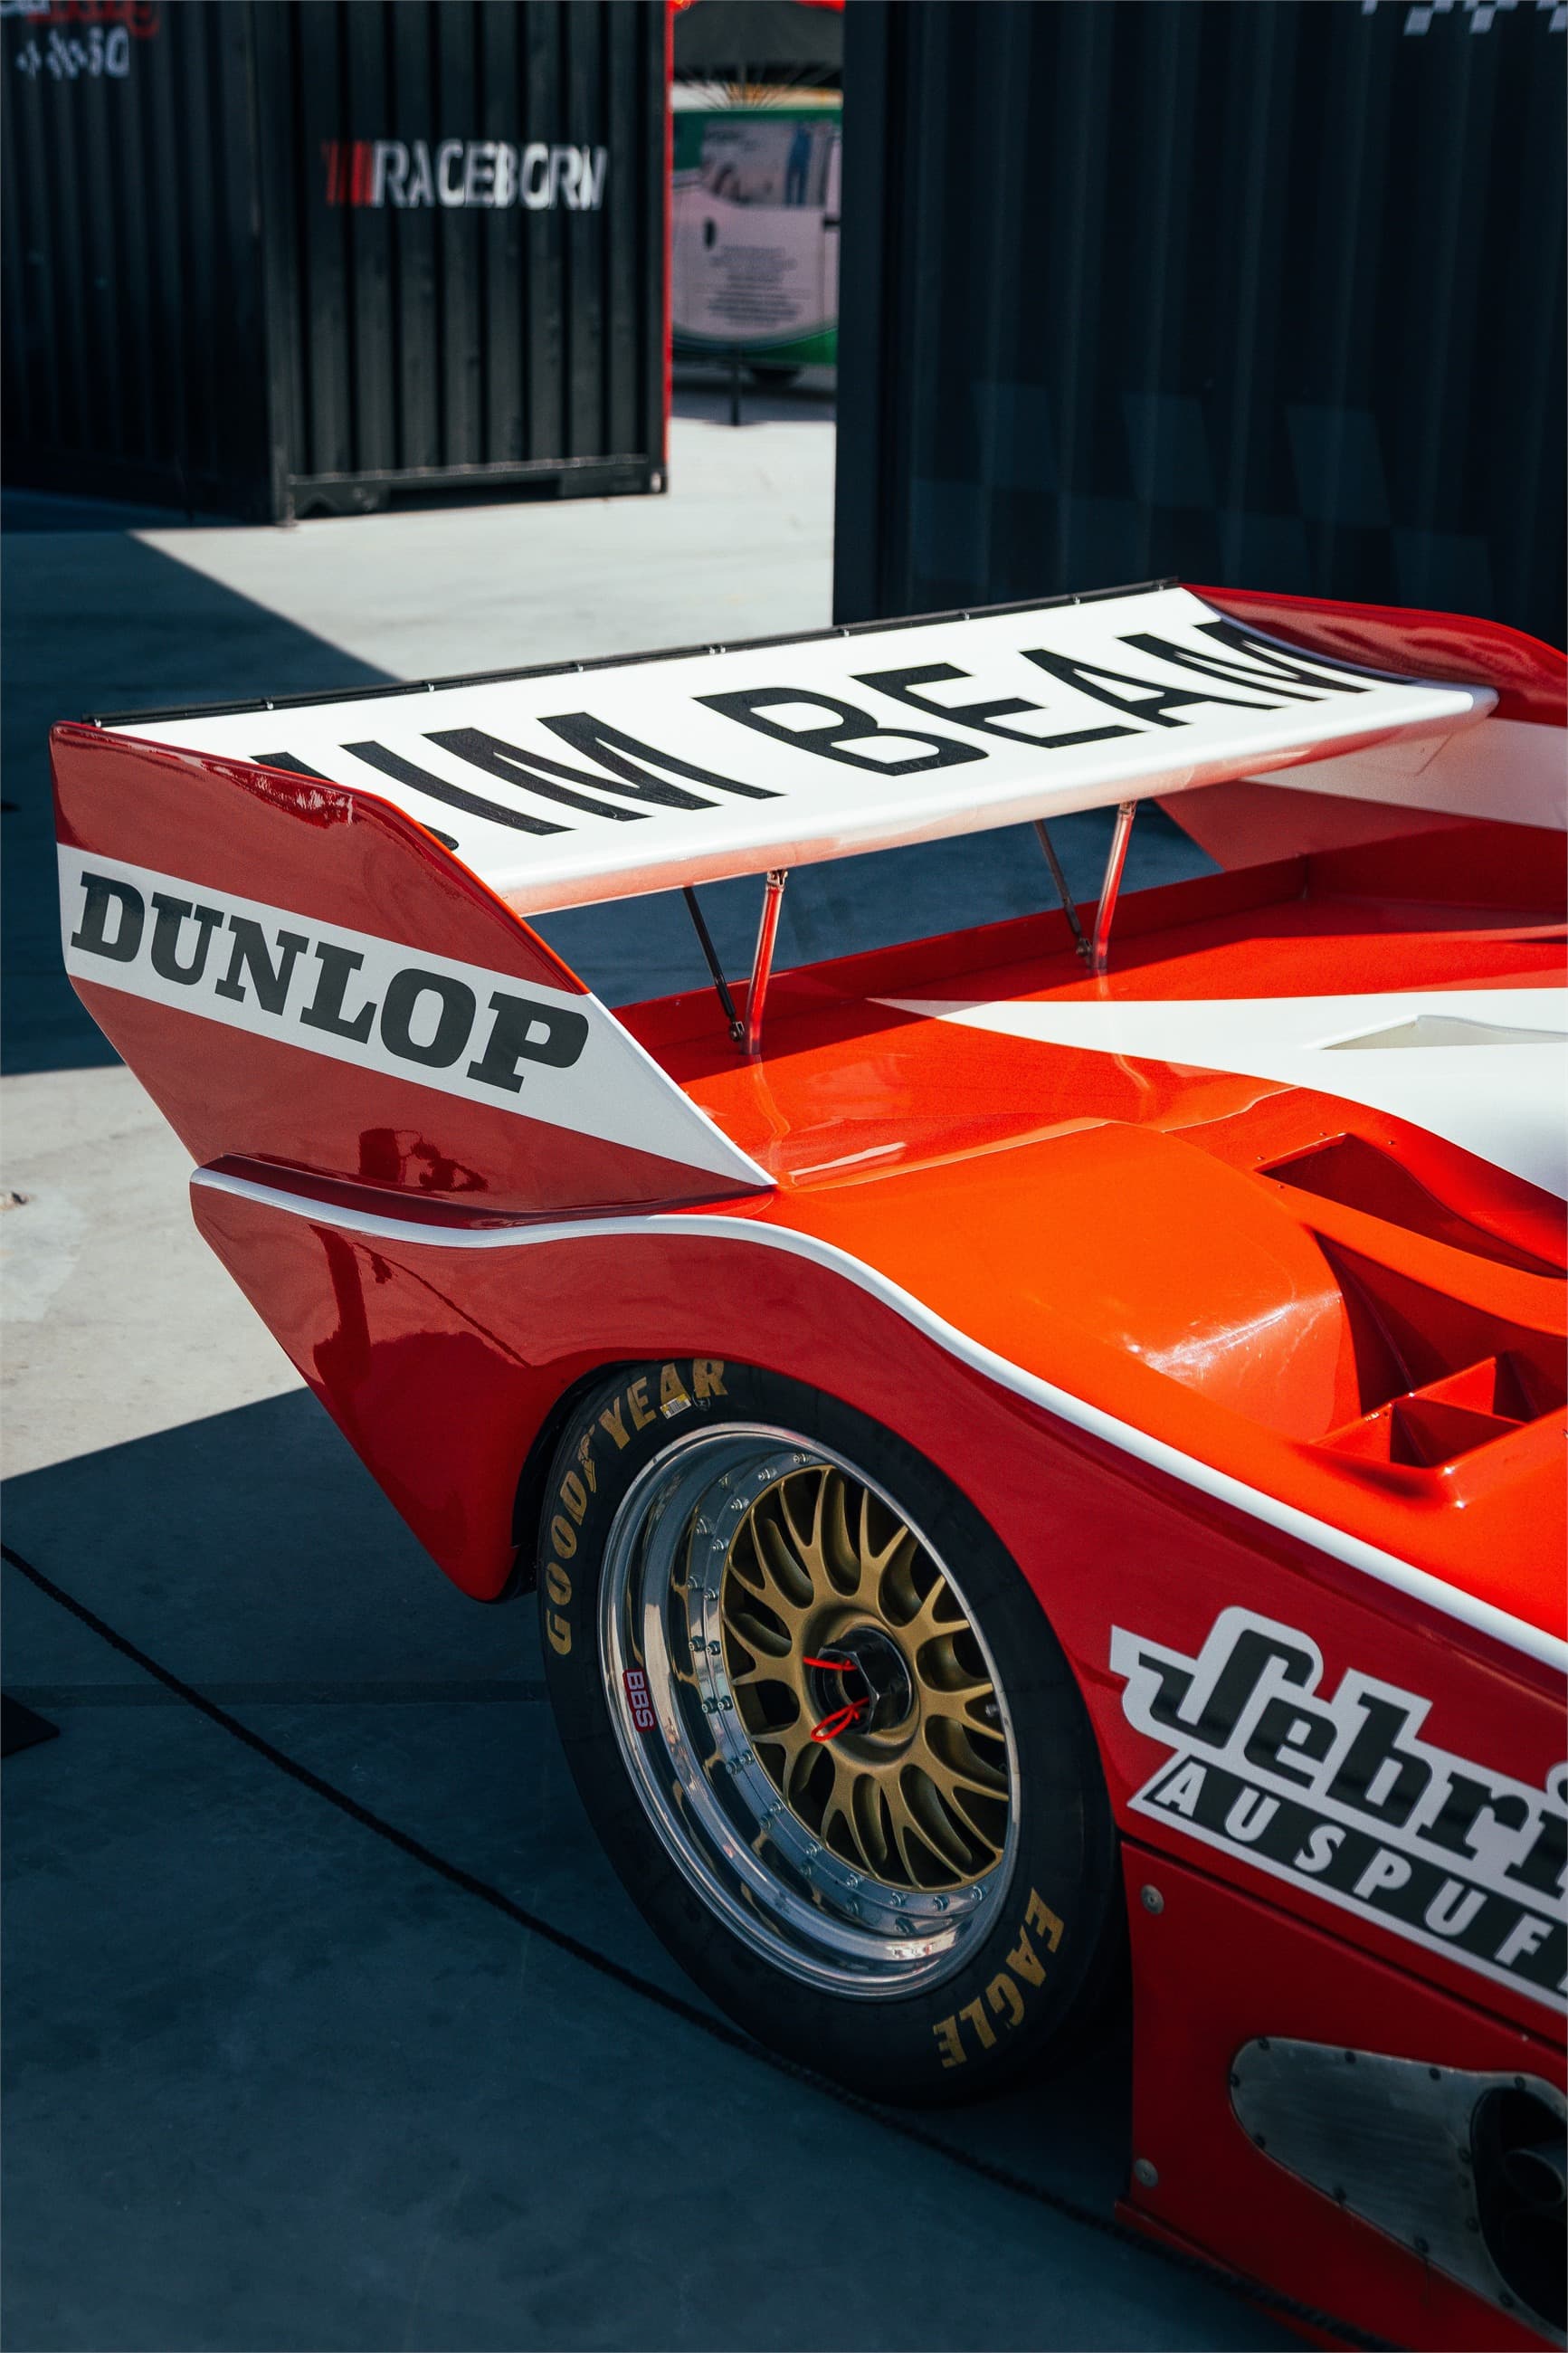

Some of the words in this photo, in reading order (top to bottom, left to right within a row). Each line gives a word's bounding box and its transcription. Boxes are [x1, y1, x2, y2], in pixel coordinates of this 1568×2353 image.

[371, 138, 608, 210] RACEBORN
[691, 619, 1419, 777] BEAM
[71, 871, 590, 1093] DUNLOP
[546, 1358, 728, 1655] GOODYEAR
[626, 1671, 654, 1728] BBS
[1154, 1758, 1568, 1991] AUSPUF
[933, 1886, 1065, 2069] EAGLE
